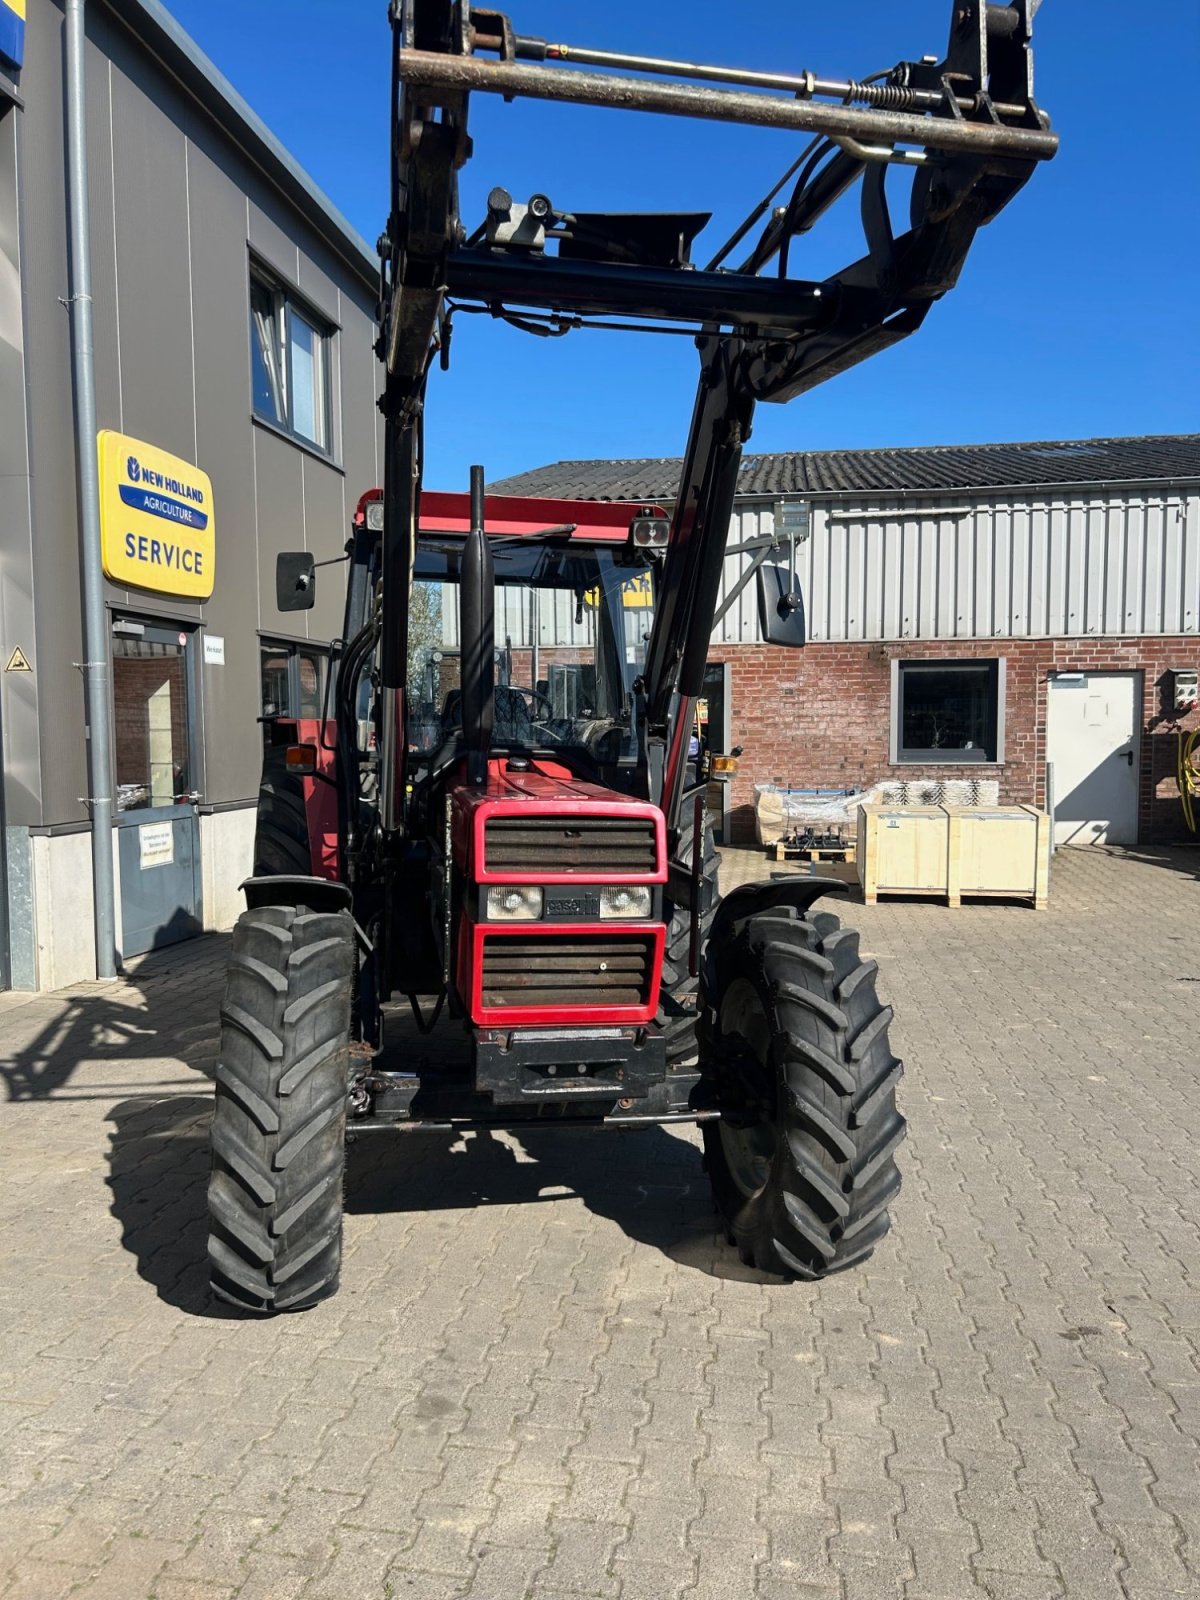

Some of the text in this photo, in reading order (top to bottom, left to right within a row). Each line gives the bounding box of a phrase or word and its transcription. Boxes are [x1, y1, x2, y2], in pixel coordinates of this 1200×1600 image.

[142, 467, 204, 504] NEW HOLLAND
[143, 495, 193, 523] AGRICULTURE
[125, 532, 203, 575] SERVICE
